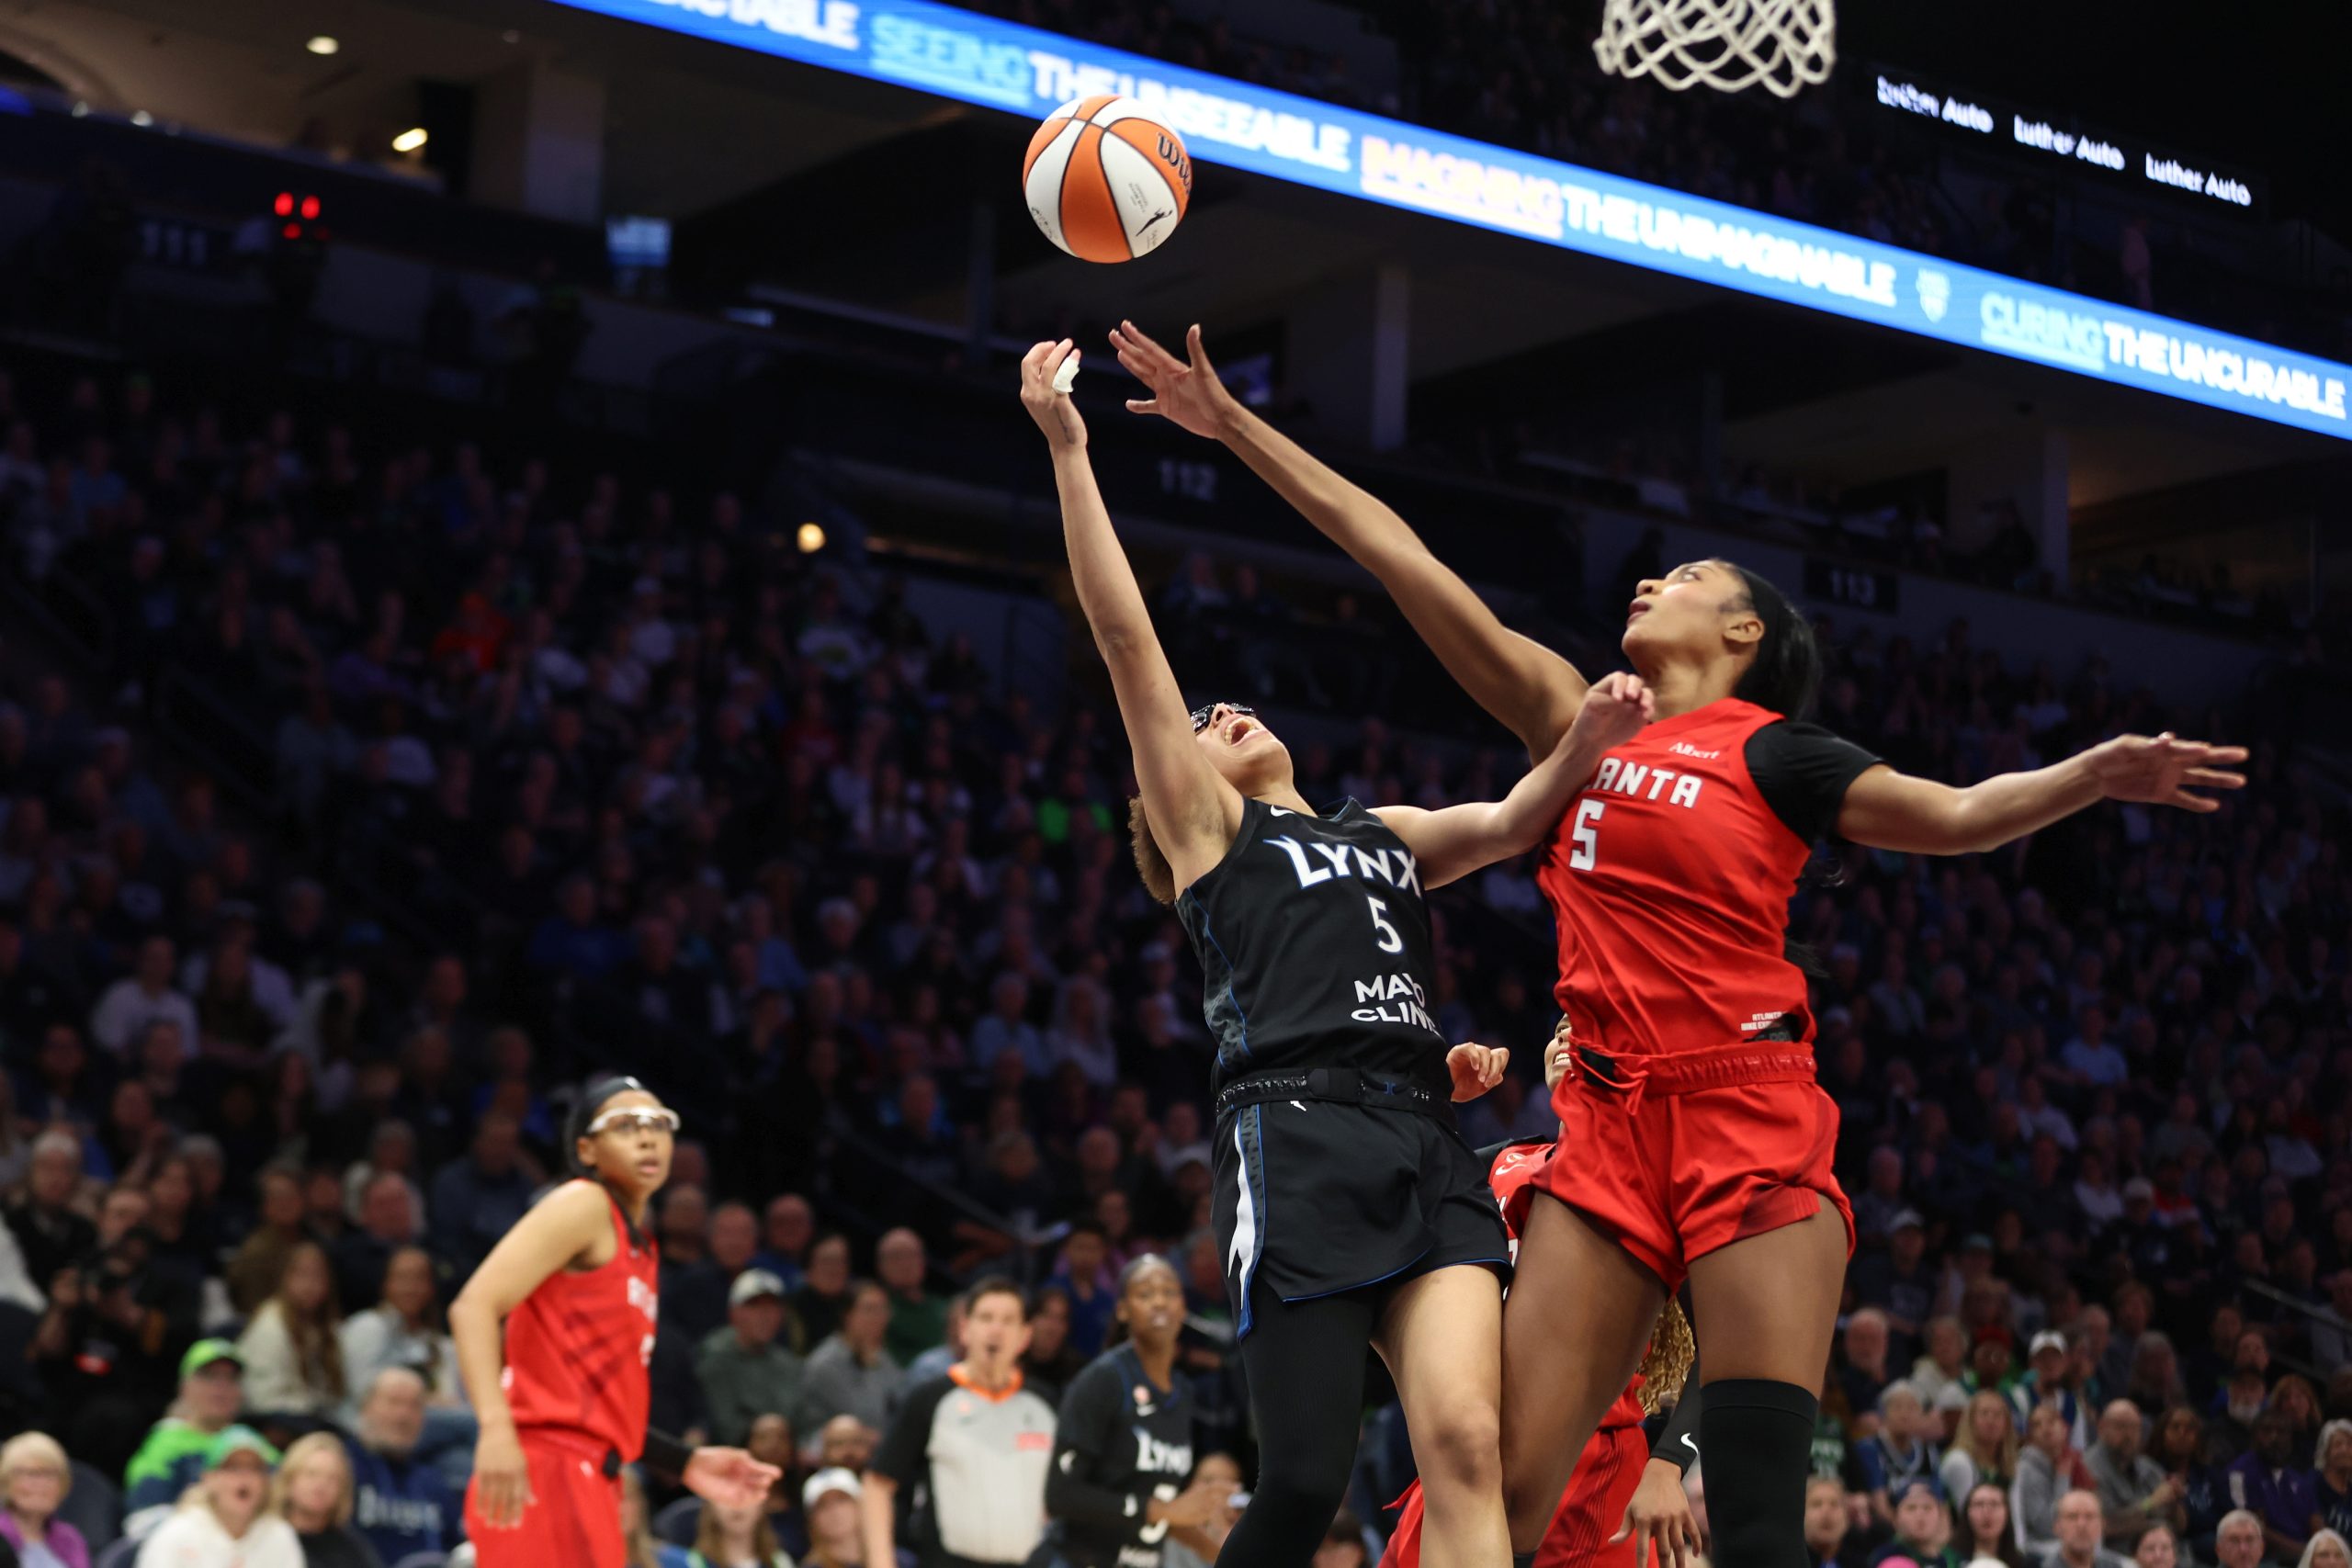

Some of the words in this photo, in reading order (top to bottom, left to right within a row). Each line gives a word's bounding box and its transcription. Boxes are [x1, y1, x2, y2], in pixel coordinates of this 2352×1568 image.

[1941, 96, 1994, 134] Auto
[2075, 135, 2125, 171] Auto
[2145, 152, 2204, 193] Luther
[2205, 172, 2251, 207] Auto
[869, 14, 1030, 90] SEEING
[1028, 52, 1116, 103] THE
[1562, 184, 1638, 243] THE
[1981, 292, 2104, 355] CURING
[2103, 321, 2169, 377] THE
[2169, 338, 2346, 420] UNCURABLE
[1668, 741, 1720, 760] Albert
[1588, 758, 1703, 808] ANTA
[1569, 798, 1605, 872] 5
[1262, 834, 1422, 900] LYNX
[1365, 893, 1406, 954] 5
